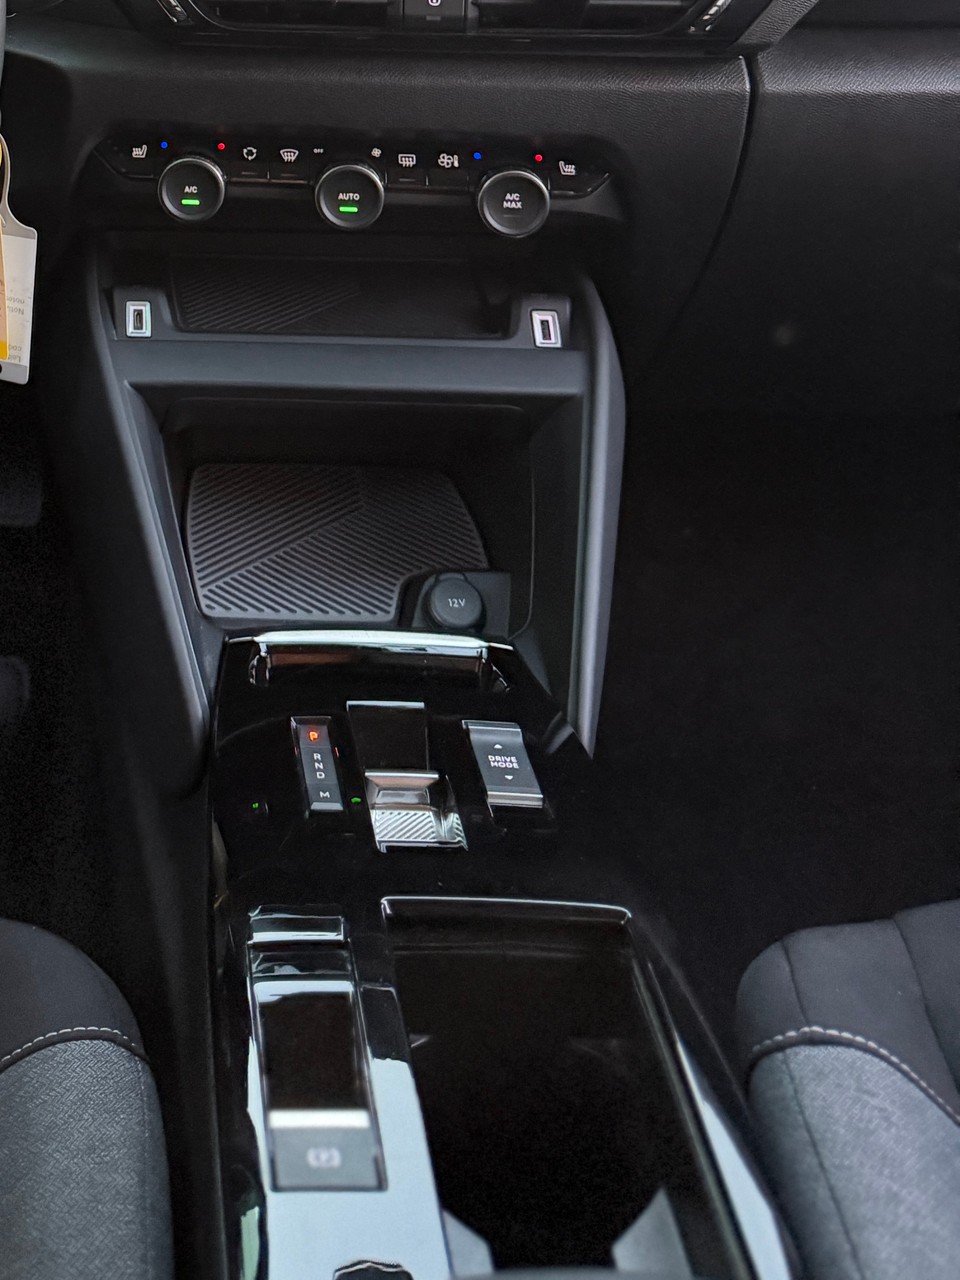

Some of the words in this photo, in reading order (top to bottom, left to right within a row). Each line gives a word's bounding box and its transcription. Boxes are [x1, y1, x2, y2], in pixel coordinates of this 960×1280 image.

[184, 185, 198, 194] A/C
[338, 192, 360, 201] AUTO
[505, 193, 520, 201] A/C
[503, 201, 522, 209] MAX
[448, 598, 466, 607] 12V
[309, 731, 318, 741] P
[313, 753, 321, 761] R
[488, 755, 518, 763] DRIVE
[314, 762, 323, 770] N
[490, 761, 520, 769] MODE
